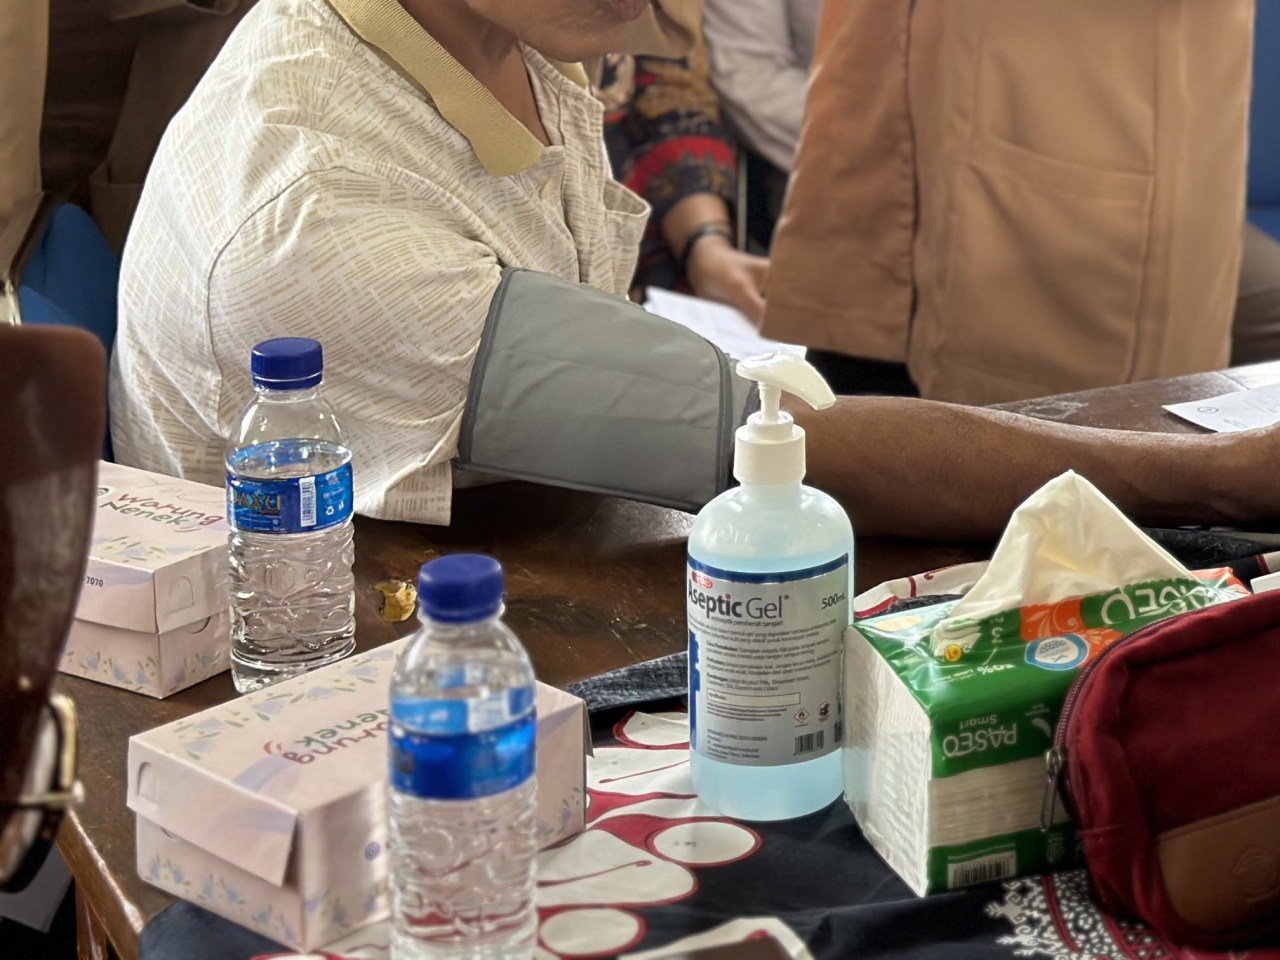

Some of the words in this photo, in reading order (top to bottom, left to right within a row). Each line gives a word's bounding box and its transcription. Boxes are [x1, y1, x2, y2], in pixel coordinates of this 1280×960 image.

[100, 501, 189, 526] Nenek
[118, 493, 224, 526] Warung
[688, 579, 743, 619] Aseptic
[746, 595, 782, 619] Gel
[992, 627, 1004, 644] 3
[959, 714, 998, 730] Smart
[282, 721, 390, 765] arung
[942, 723, 1018, 758] PASEO
